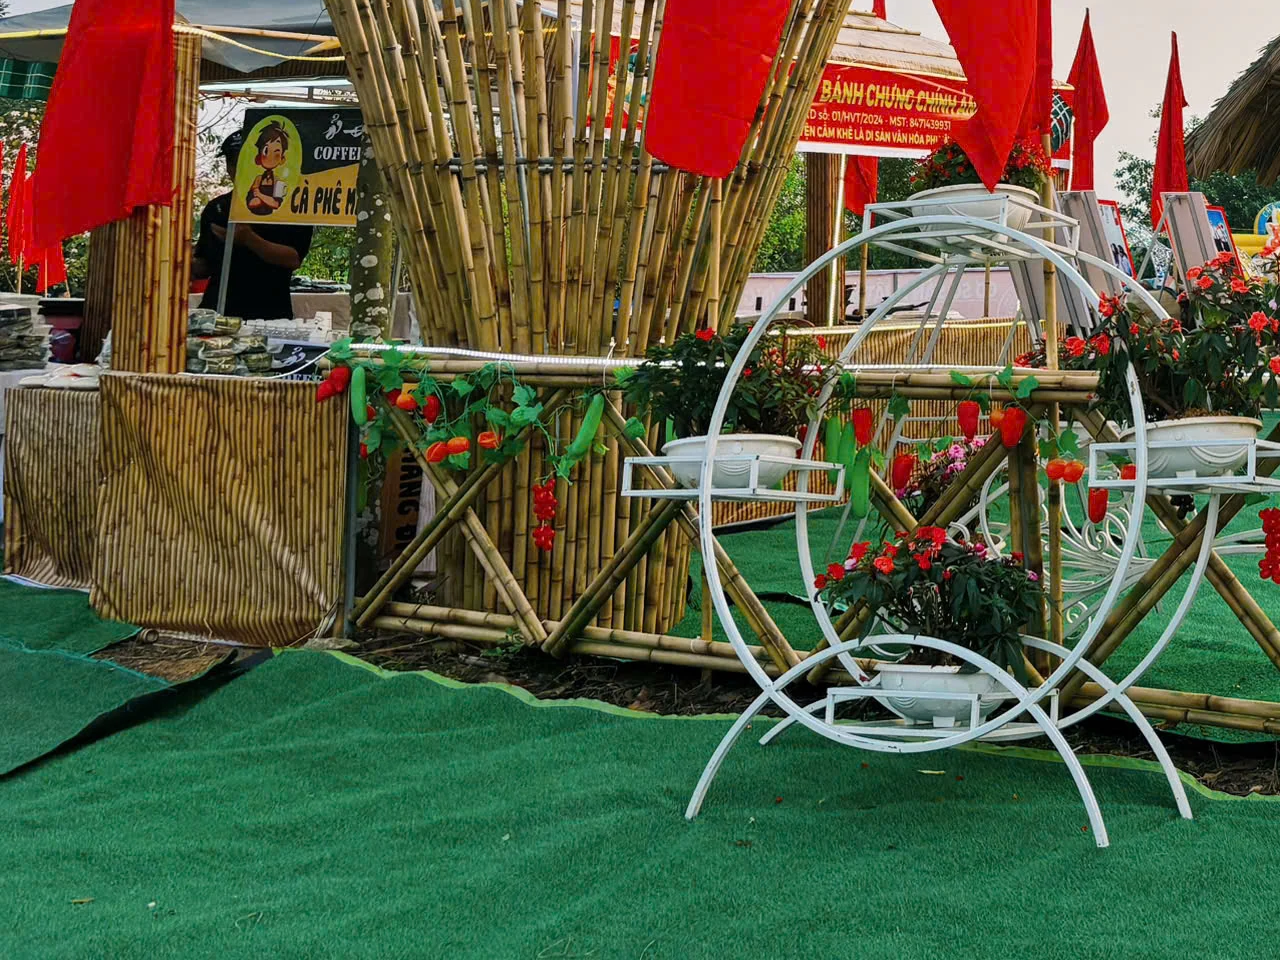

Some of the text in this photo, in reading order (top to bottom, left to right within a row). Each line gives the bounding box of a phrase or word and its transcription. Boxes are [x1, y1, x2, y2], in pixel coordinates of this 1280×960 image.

[821, 75, 864, 105] BÁNH
[867, 84, 915, 112] CHƯNG
[916, 87, 957, 115] CHÍNH
[831, 110, 883, 126] 01/HVT/2024
[889, 116, 909, 128] MST:
[854, 127, 865, 141] LÀ
[865, 129, 874, 142] DI
[875, 128, 891, 143] SẢN
[290, 179, 358, 215] CÀ PHÊ M
